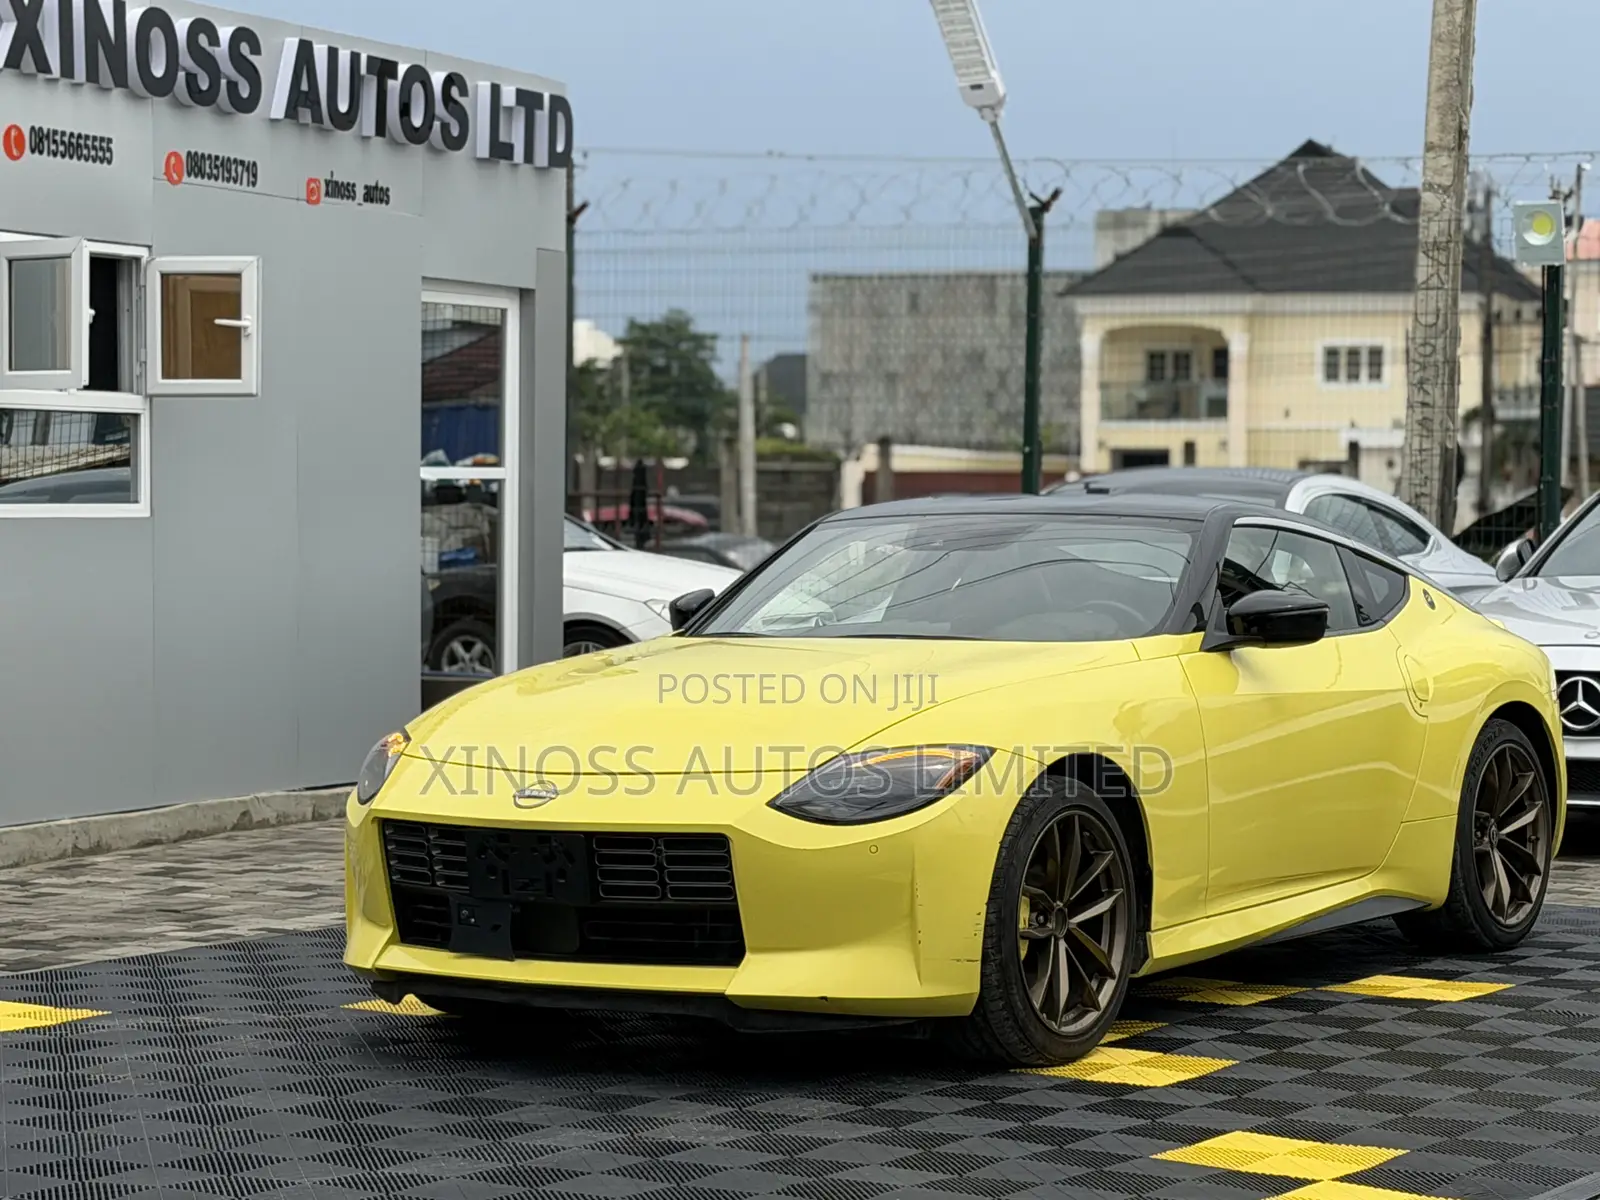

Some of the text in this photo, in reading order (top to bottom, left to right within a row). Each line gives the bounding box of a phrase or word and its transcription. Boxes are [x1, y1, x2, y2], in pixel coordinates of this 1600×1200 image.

[3, 0, 574, 168] XINOSS AUTOS LTD
[28, 125, 114, 166] 08155665555
[185, 150, 259, 188] 08035193719
